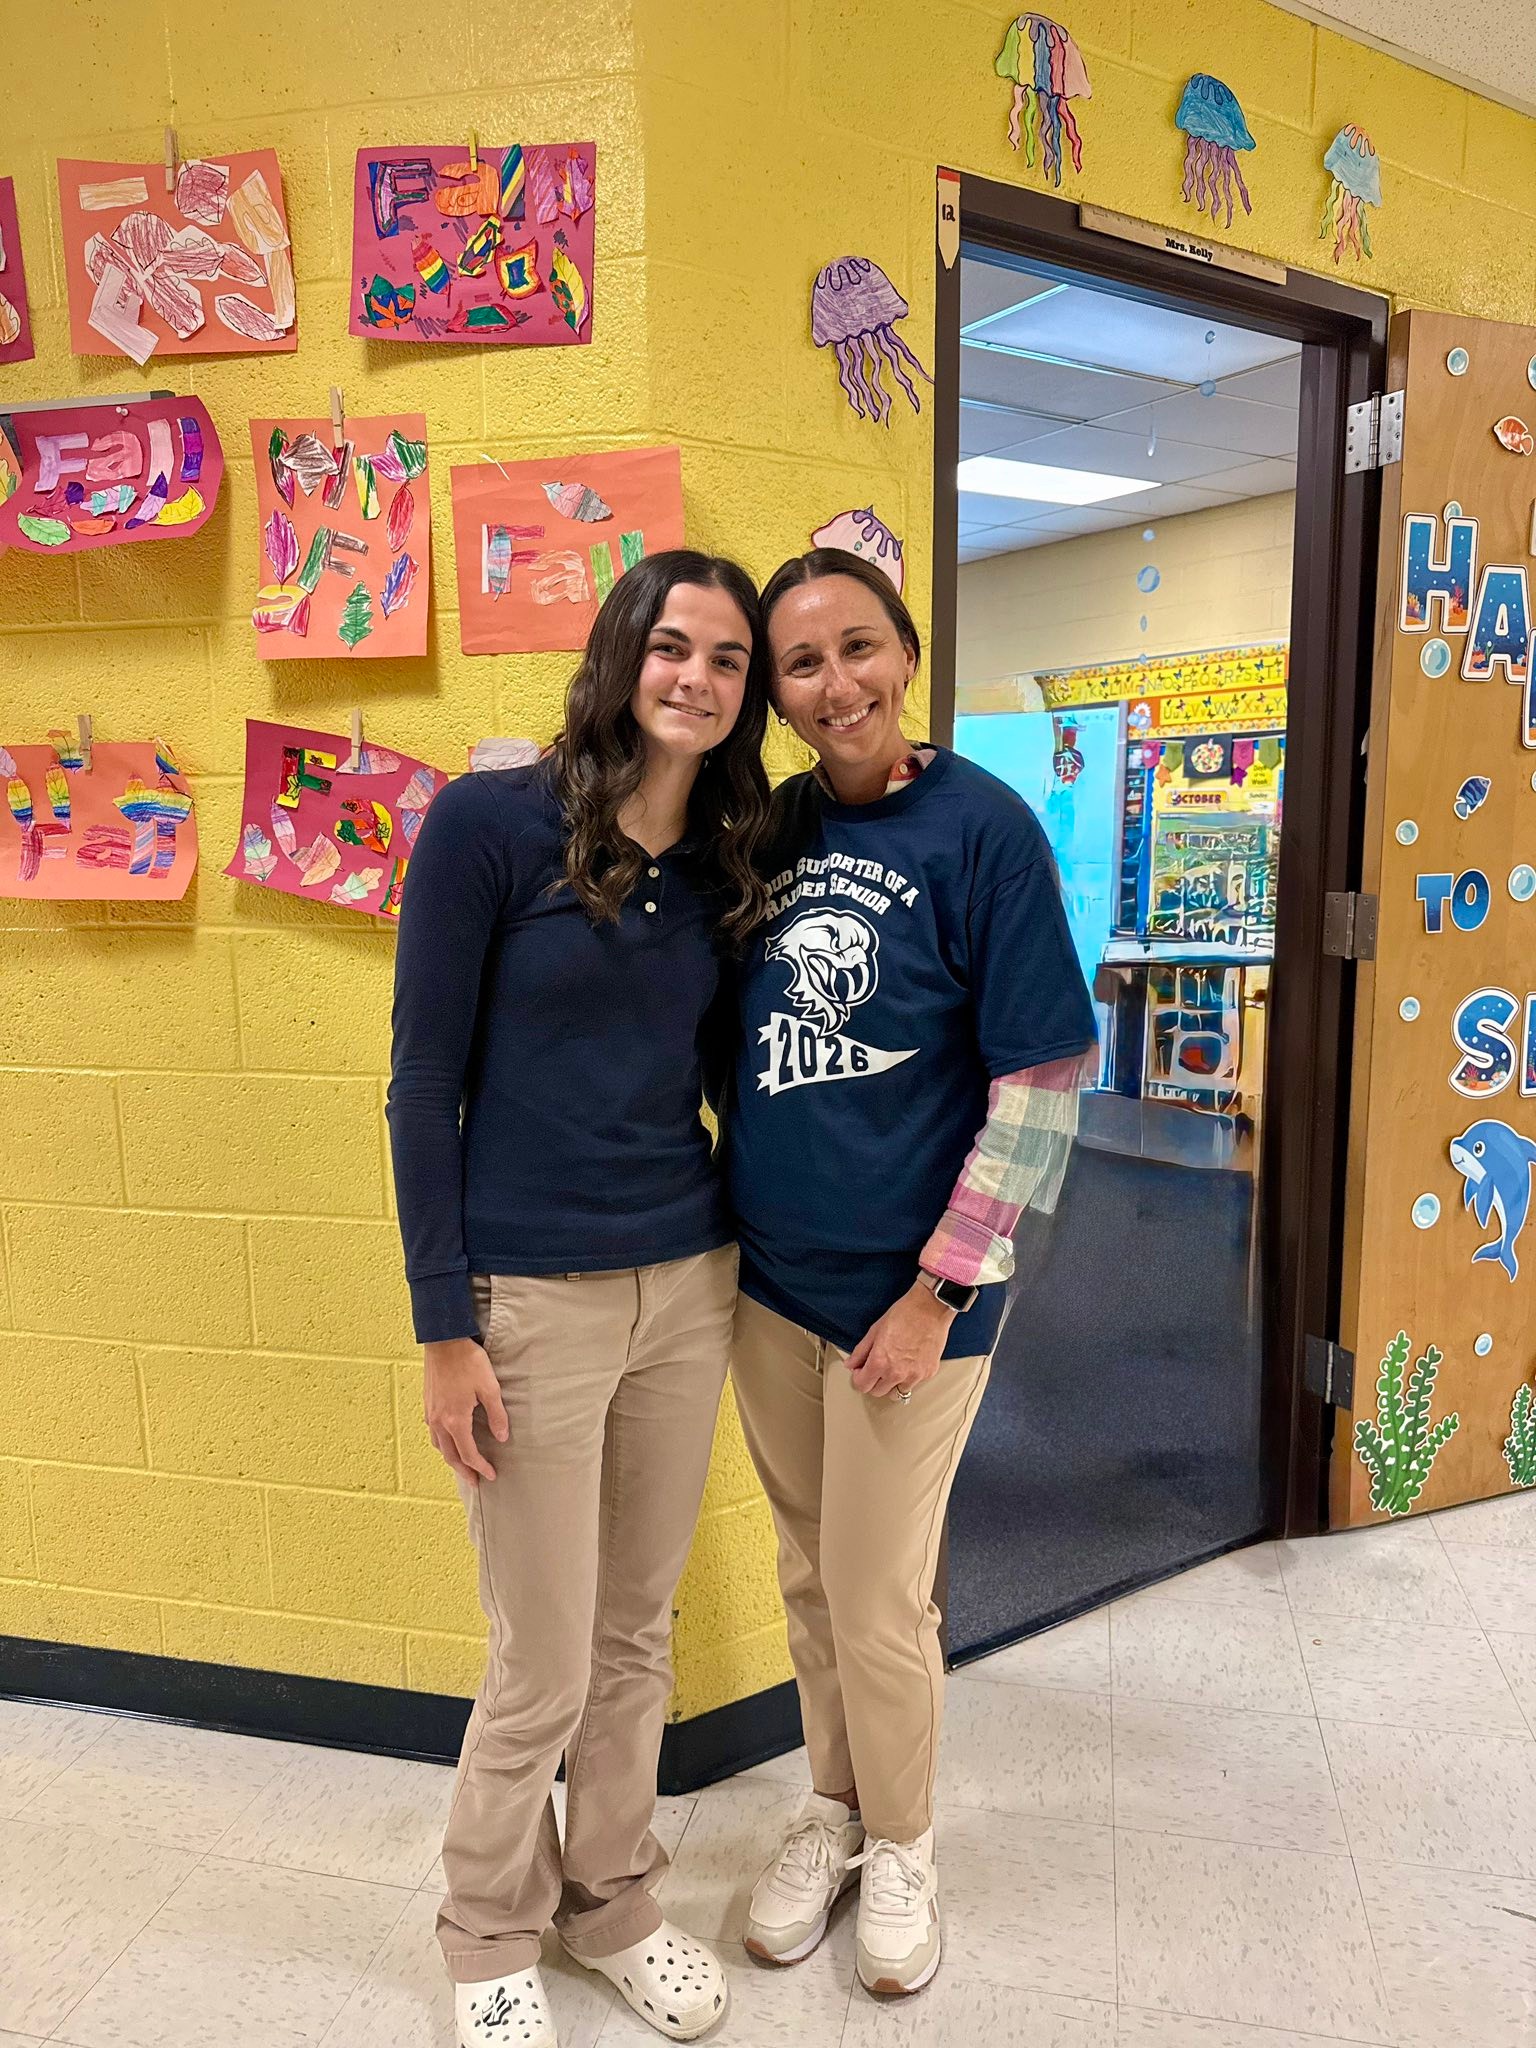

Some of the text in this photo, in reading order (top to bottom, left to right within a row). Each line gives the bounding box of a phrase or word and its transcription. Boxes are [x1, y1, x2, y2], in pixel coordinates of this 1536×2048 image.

[1165, 237, 1187, 253] Mrs.
[1189, 244, 1213, 262] Kelly
[1398, 512, 1536, 750] HA
[796, 852, 884, 883] SUPORTER
[884, 869, 908, 895] OF
[900, 886, 920, 909] A
[829, 872, 892, 916] SENIOR
[1416, 870, 1491, 936] TO
[778, 1018, 869, 1086] 2026
[1450, 987, 1536, 1099] S
